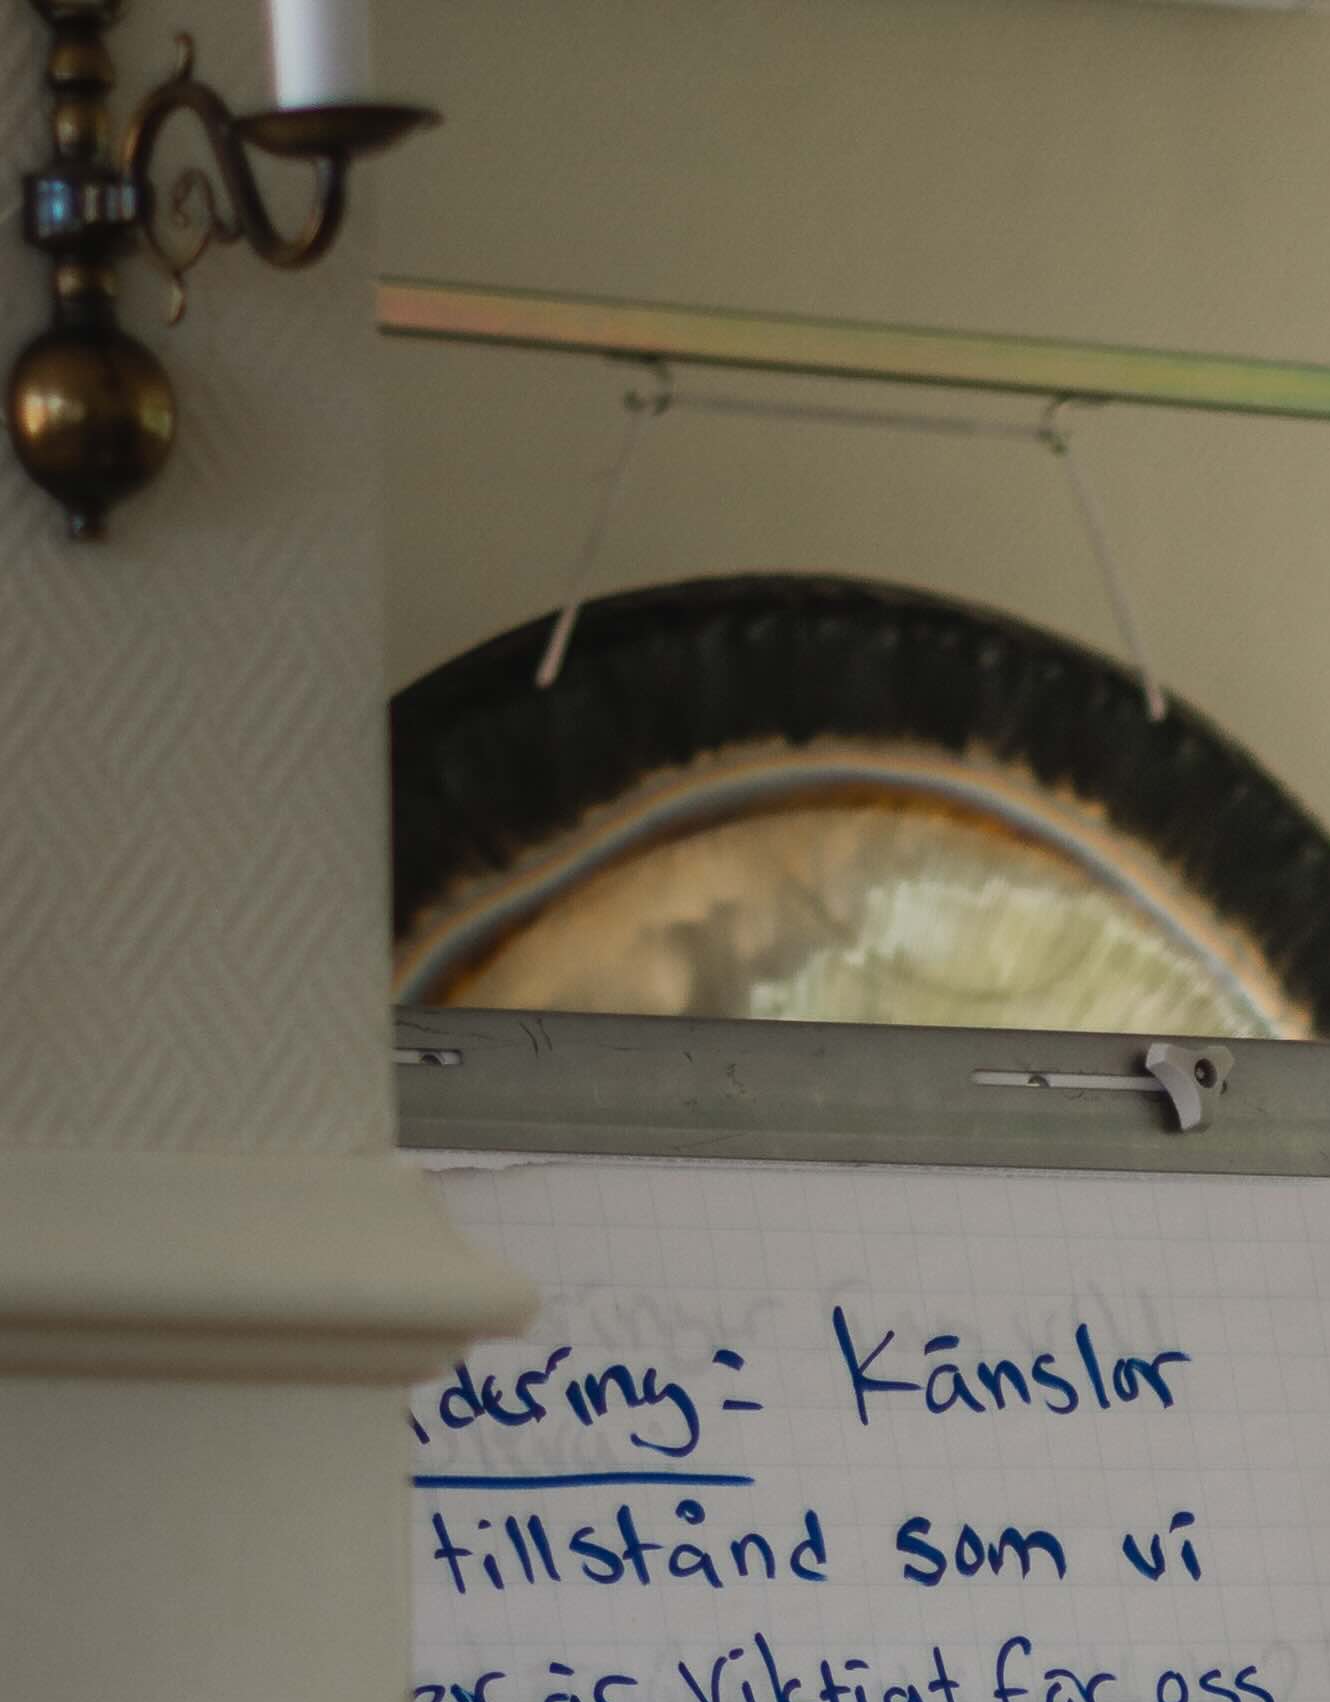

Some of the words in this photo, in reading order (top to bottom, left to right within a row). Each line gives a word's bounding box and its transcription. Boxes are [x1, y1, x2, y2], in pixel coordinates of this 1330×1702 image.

[832, 1306, 1192, 1424] Känslor
[432, 1498, 829, 1594] tillstånd
[895, 1515, 1067, 1585] som
[1122, 1511, 1203, 1581] vi
